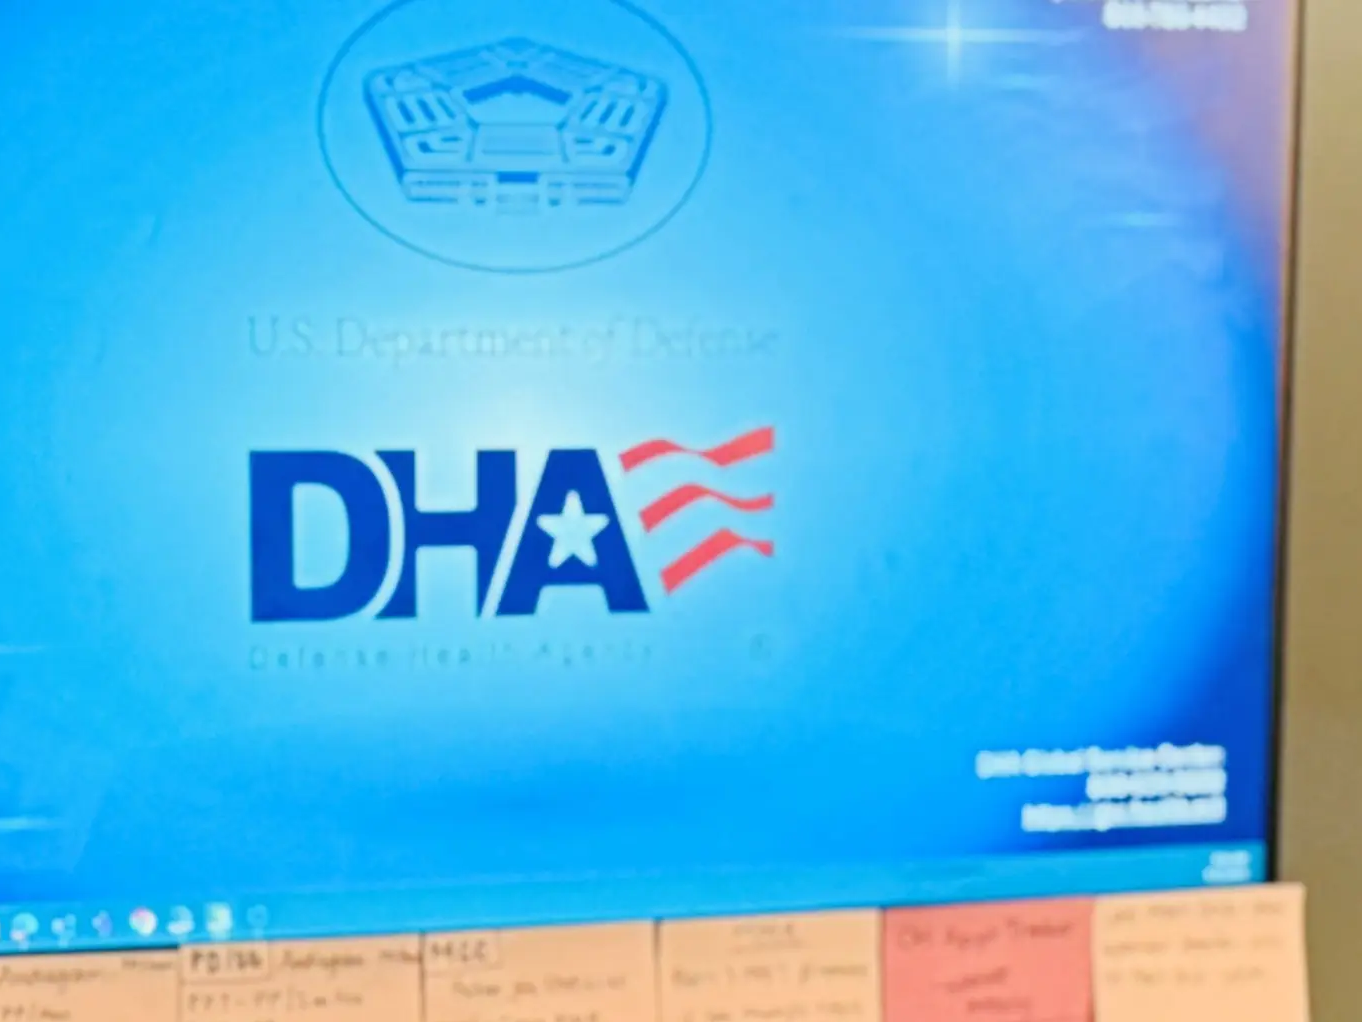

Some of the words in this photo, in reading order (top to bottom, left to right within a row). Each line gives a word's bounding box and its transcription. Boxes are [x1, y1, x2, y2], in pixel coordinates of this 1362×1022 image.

[337, 315, 576, 370] Department
[633, 314, 781, 359] Defense
[249, 448, 651, 623] DHA
